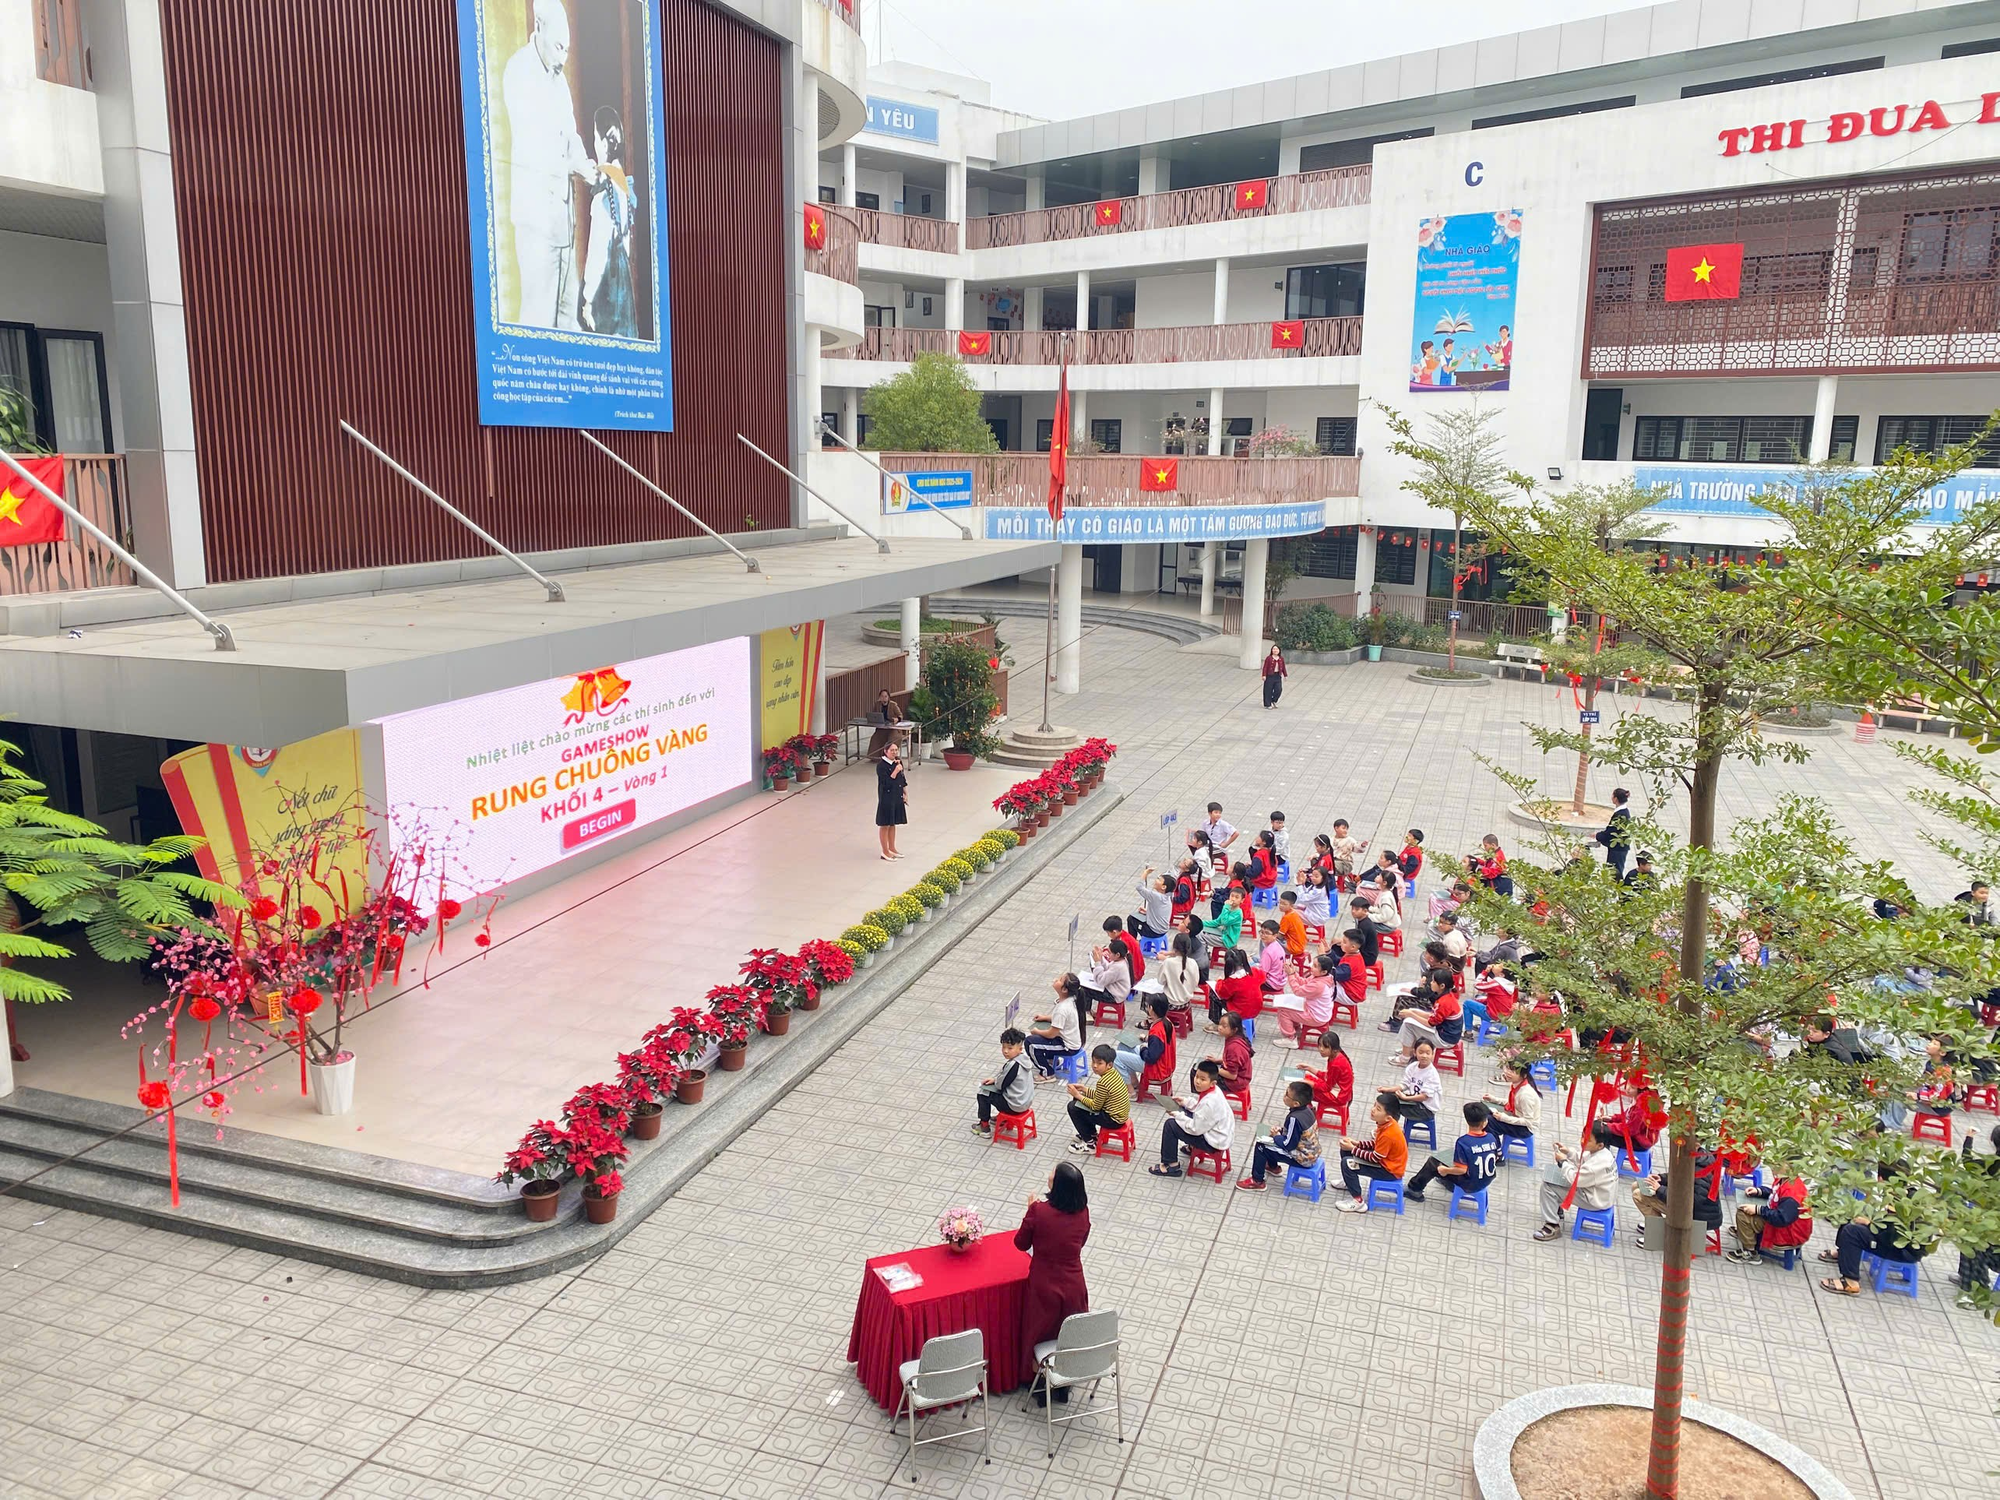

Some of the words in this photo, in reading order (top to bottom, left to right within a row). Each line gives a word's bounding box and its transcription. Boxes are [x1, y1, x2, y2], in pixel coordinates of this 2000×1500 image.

[881, 108, 915, 130] YÊU
[1718, 119, 1807, 157] THI
[1826, 99, 1950, 144] ĐUA
[1465, 161, 1484, 187] C
[507, 364, 523, 375] Nam
[551, 356, 565, 367] Nam
[1690, 478, 1757, 502] TRƯỜNG
[997, 511, 1029, 535] MỖI
[1082, 515, 1102, 534] CÔ
[1108, 515, 1143, 534] GIÁO
[1148, 513, 1164, 534] LÀ
[1169, 515, 1196, 537] MỘT
[1201, 511, 1225, 532] TẤM
[1229, 515, 1262, 532] GƯƠNG
[1265, 514, 1282, 531] ĐẠO
[466, 747, 508, 770] Nhiệt
[512, 739, 535, 757] liệt
[539, 731, 570, 748] chào
[574, 719, 611, 738] mừng
[613, 711, 632, 726] các
[634, 705, 650, 720] thí
[653, 698, 675, 715] sinh
[678, 692, 697, 708] đến
[699, 687, 716, 701] với
[561, 723, 650, 763] GAMESHOW
[471, 775, 547, 821] RUNG
[554, 741, 651, 792] CHUÔNG
[655, 723, 708, 756] VÀNG
[312, 784, 338, 804] chữ
[540, 787, 587, 824] KHỐI
[593, 786, 603, 803] 4
[624, 771, 656, 793] Vòng
[660, 764, 668, 780] 1
[579, 808, 623, 838] BEGIN
[1474, 1152, 1497, 1180] 10
